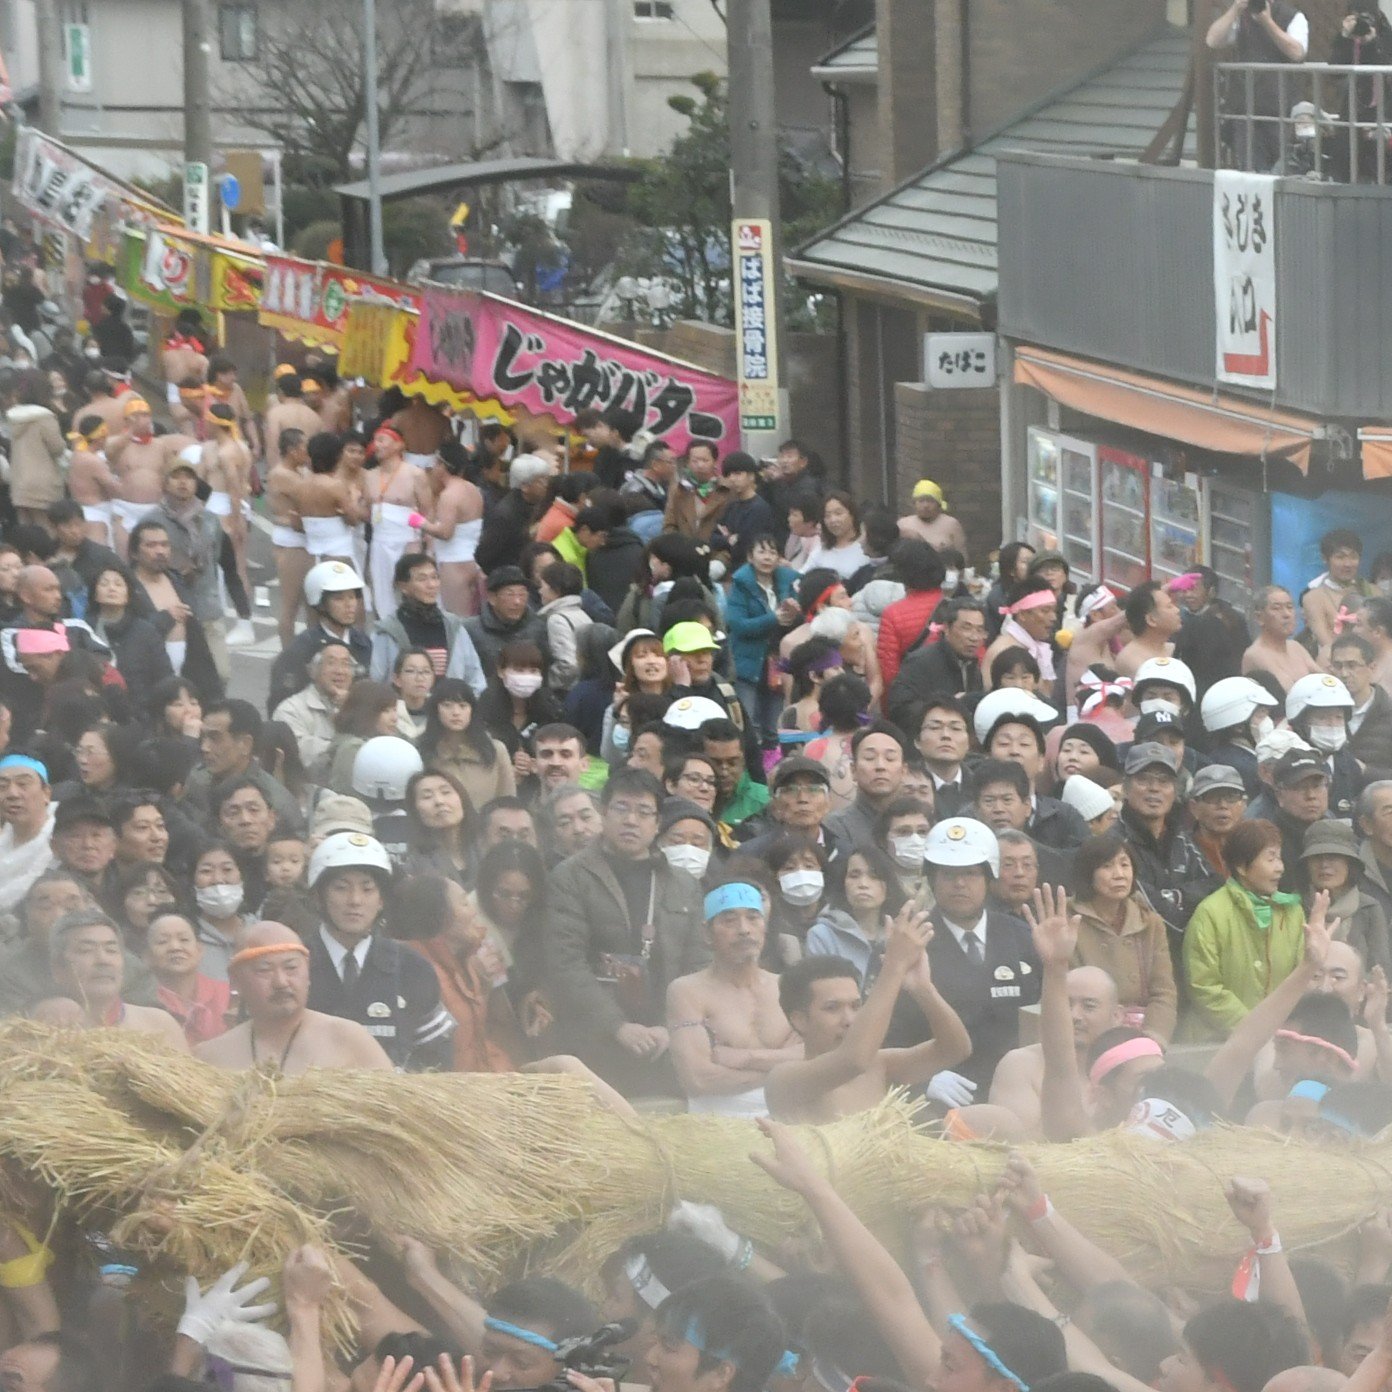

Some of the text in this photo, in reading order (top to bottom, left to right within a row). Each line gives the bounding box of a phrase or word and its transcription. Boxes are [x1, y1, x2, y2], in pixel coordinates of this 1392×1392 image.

[741, 256, 767, 378] ばば接骨院
[494, 322, 724, 441] じゃがバター
[939, 348, 986, 374] たばこ
[1155, 1108, 1181, 1129] 厄
